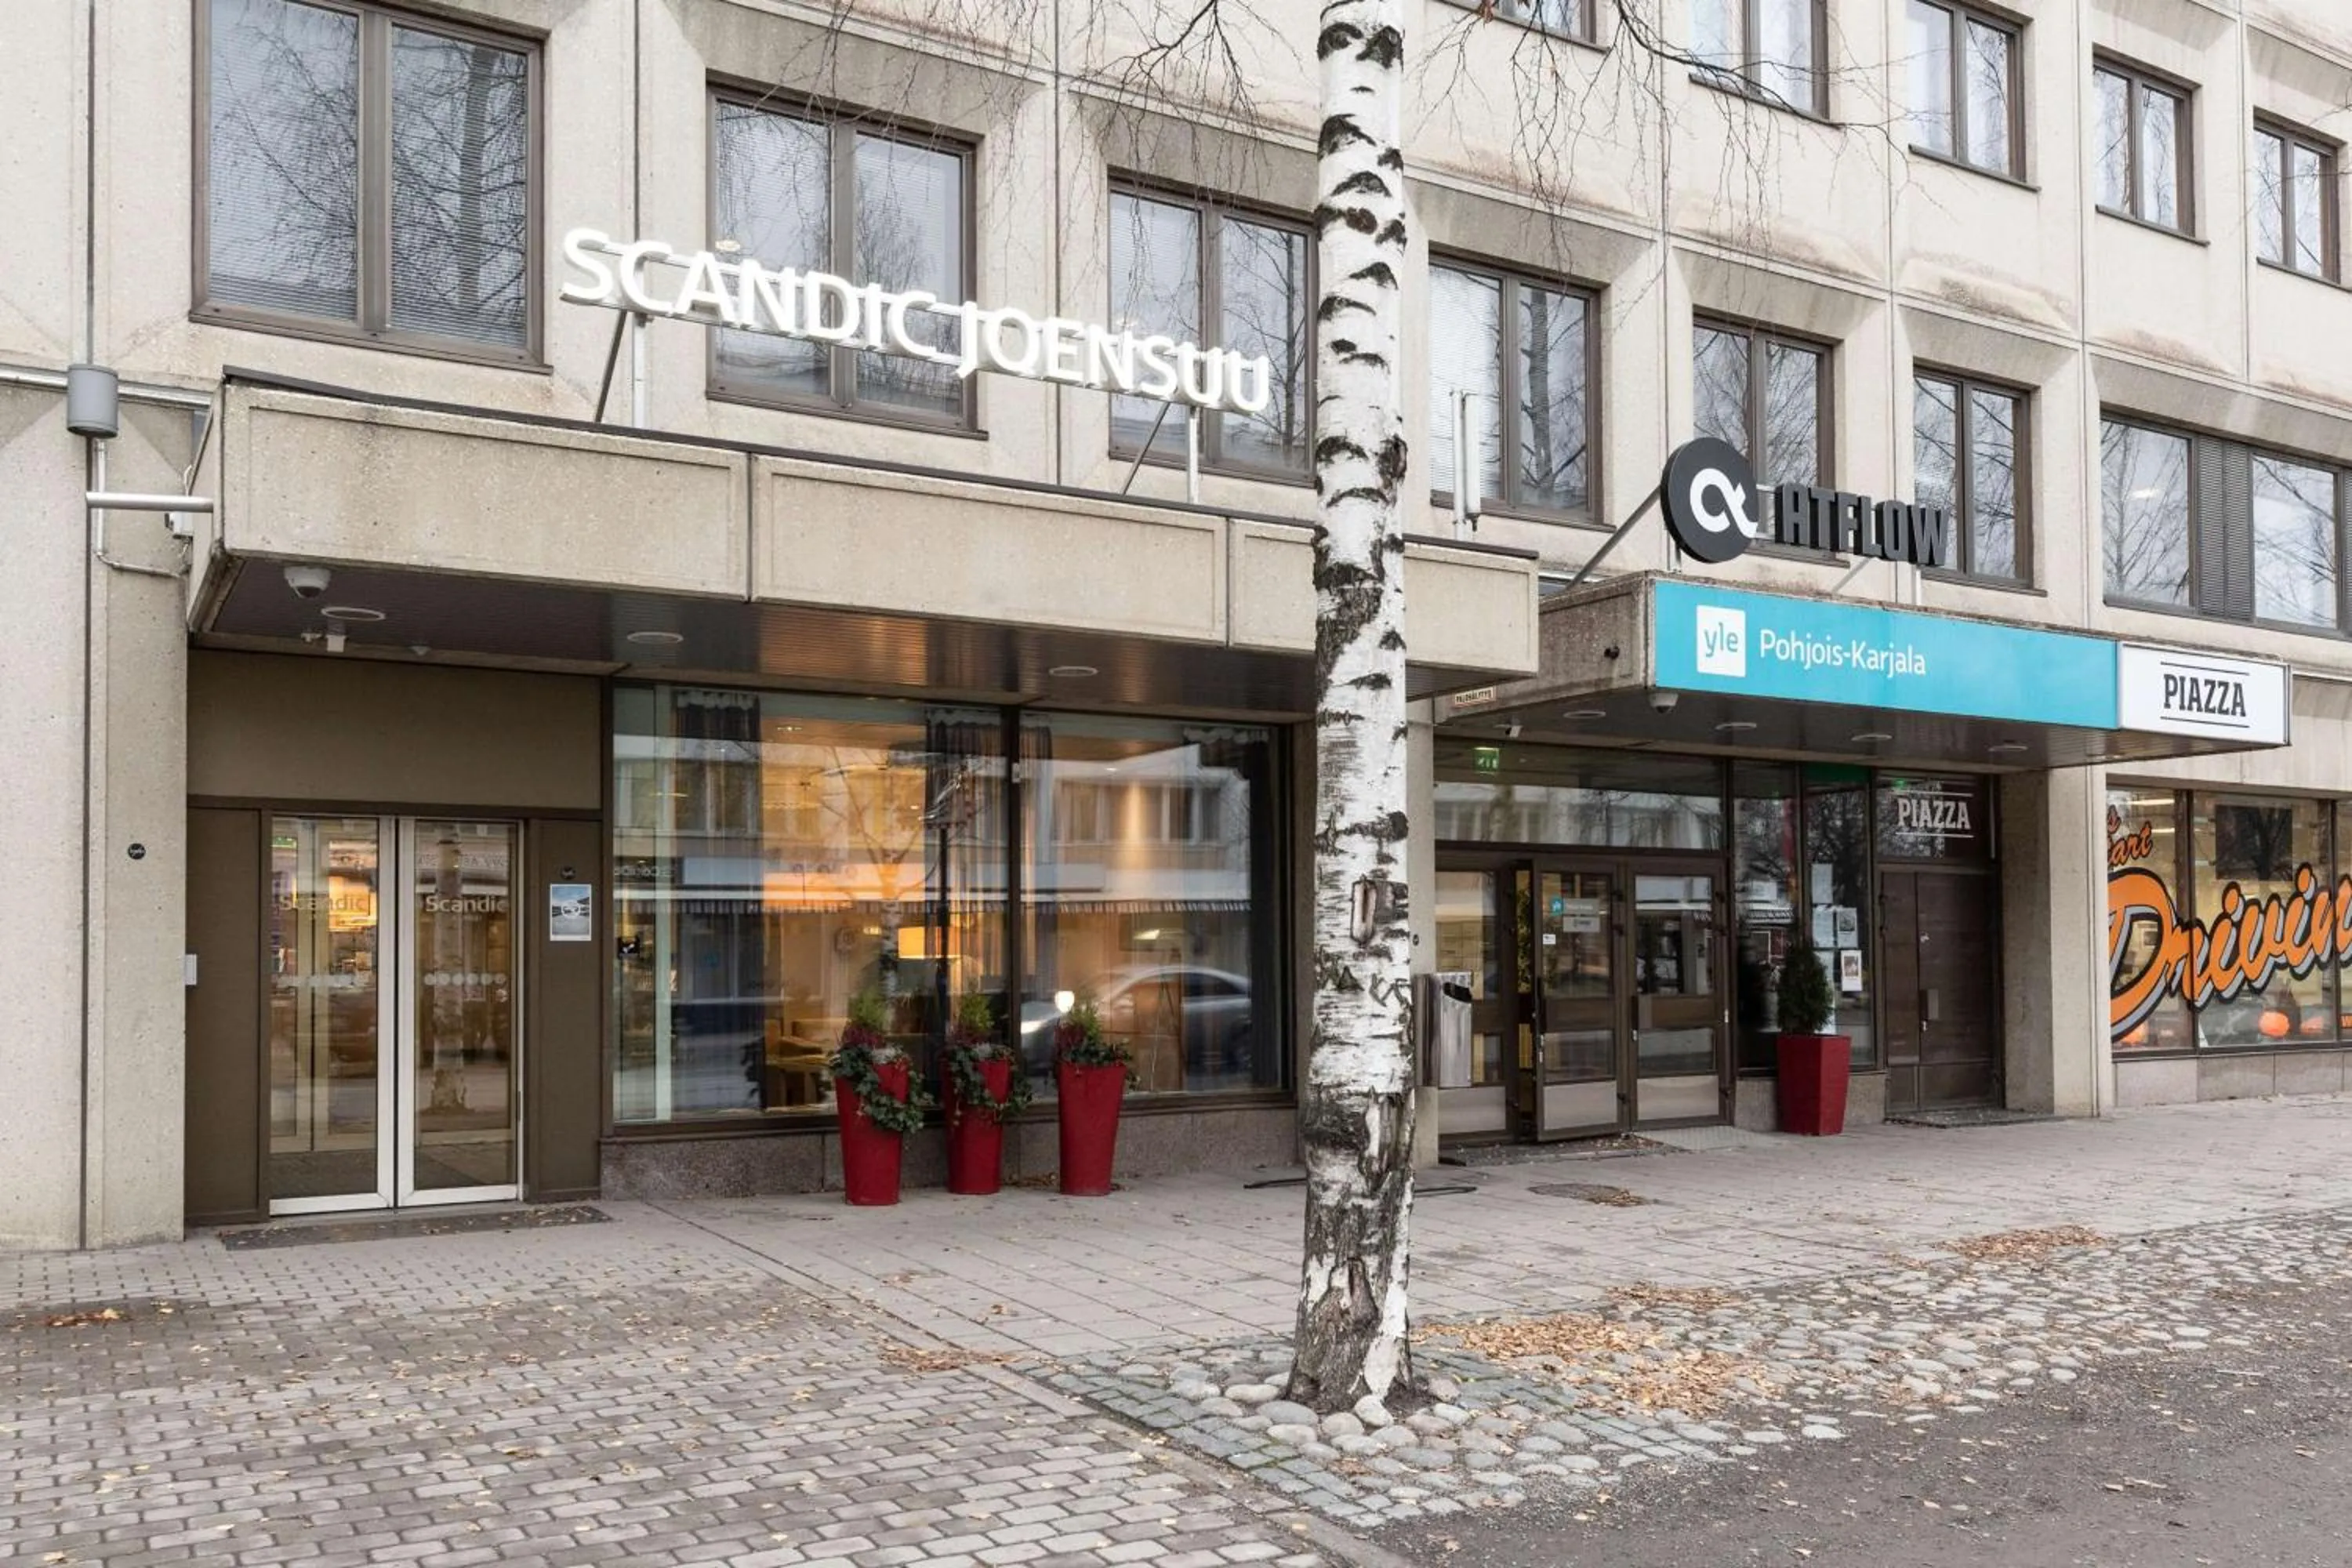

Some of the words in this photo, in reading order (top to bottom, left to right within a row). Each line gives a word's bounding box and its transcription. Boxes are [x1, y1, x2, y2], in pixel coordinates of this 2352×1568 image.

[563, 228, 936, 359] SCANDIC
[955, 300, 1269, 413] JOENSUU
[1704, 622, 1739, 658] yle
[1759, 629, 1926, 678] Pohjois-Karjala
[2163, 673, 2247, 717] PIAZZA
[1897, 798, 1971, 829] PIAZZA
[426, 894, 509, 913] Scandic
